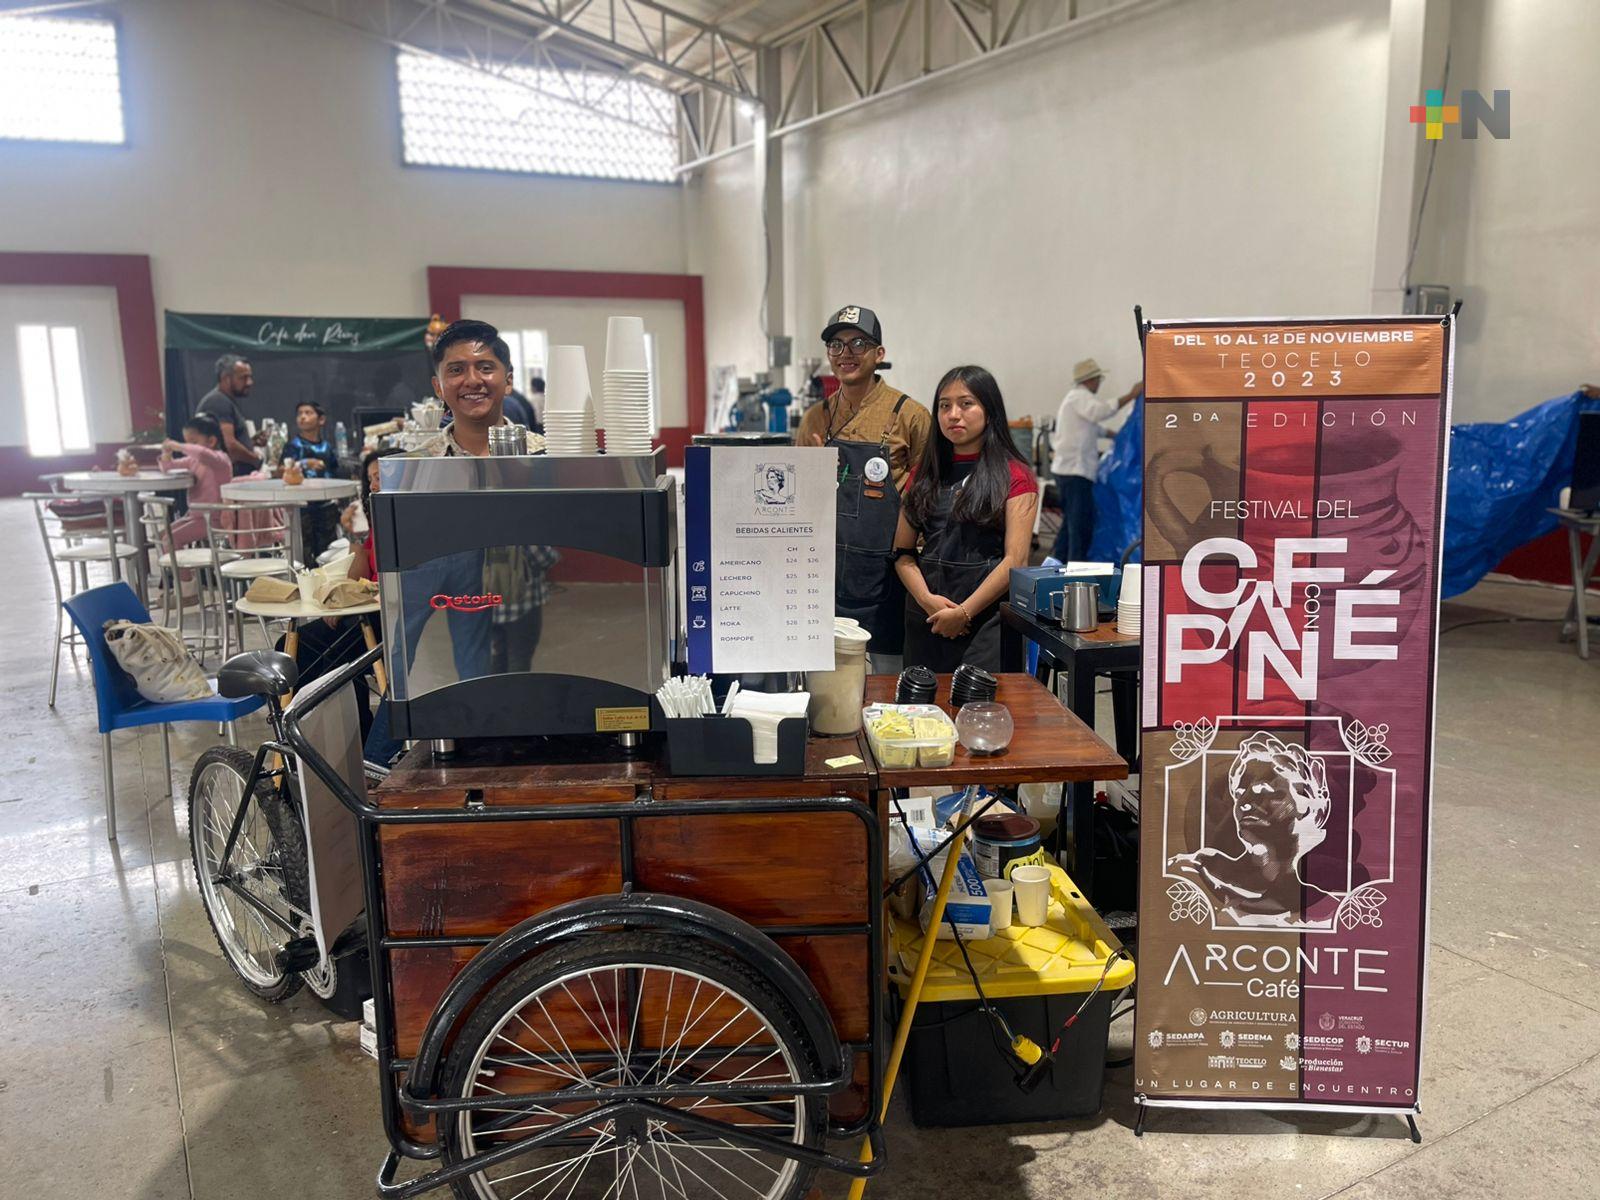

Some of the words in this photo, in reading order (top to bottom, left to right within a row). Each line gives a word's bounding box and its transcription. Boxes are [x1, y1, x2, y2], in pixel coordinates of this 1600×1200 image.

[1174, 334, 1205, 346] DEL
[1214, 334, 1231, 346] 10
[1236, 332, 1258, 346] AL
[1262, 332, 1280, 345] 12
[1284, 332, 1307, 345] DE
[1310, 330, 1414, 344] NOVIEMBRE
[1218, 350, 1371, 368] TEOCELO
[1244, 370, 1342, 388] 2023
[1246, 408, 1416, 428] EDICIÓN
[1210, 500, 1308, 520] FESTIVAL
[1316, 500, 1359, 519] DEL
[770, 526, 814, 534] CALIENTES
[1304, 583, 1320, 629] CON
[970, 878, 984, 897] 500
[1164, 944, 1389, 992] ARCONTE
[1246, 978, 1300, 998] Café
[1209, 1010, 1297, 1022] AGRICULTURA
[1166, 1032, 1205, 1040] SEDARPA
[1237, 1033, 1273, 1041] SEDEMA
[1303, 1036, 1345, 1045] SEDECOP
[1374, 1039, 1410, 1048] SECTUR
[1236, 1057, 1267, 1066] TEOCELO
[1298, 1058, 1344, 1067] Producción
[1308, 1065, 1344, 1074] Bienestar
[1136, 1078, 1158, 1088] UN
[1172, 1080, 1238, 1090] LUGAR
[1252, 1081, 1274, 1090] DE
[1289, 1082, 1414, 1096] ENCUENTRO
